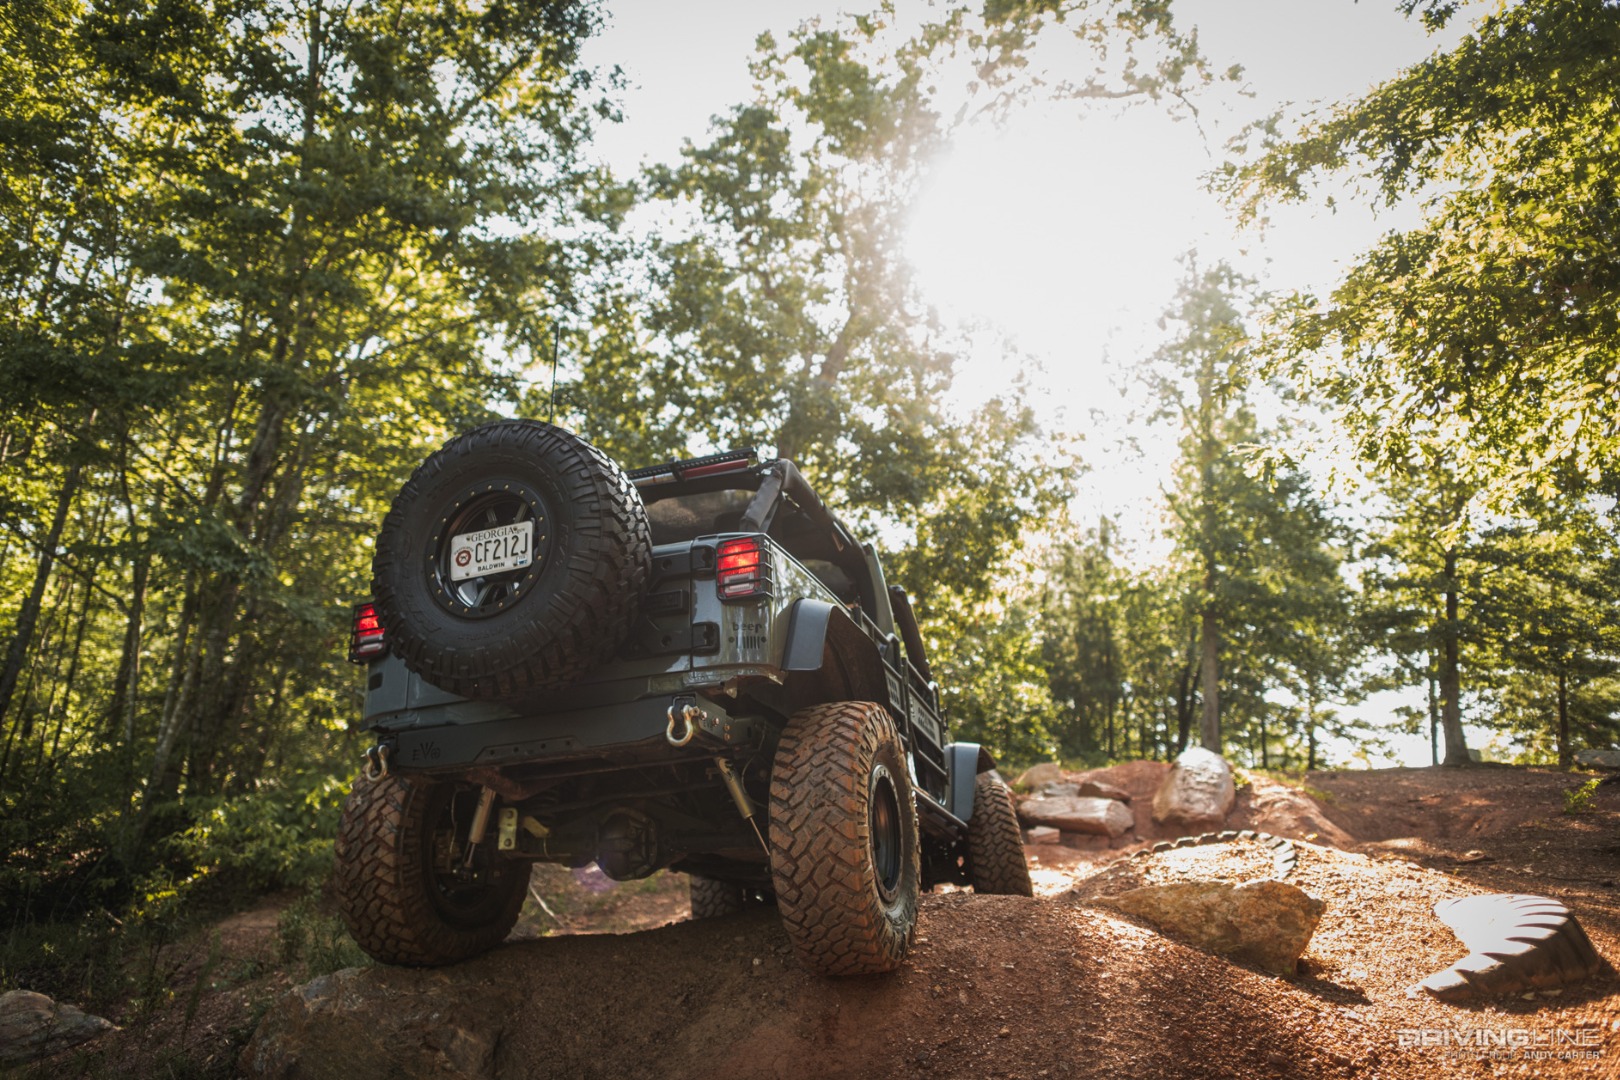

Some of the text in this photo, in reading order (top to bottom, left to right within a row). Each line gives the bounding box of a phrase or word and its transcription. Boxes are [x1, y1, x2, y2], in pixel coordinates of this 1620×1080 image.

[471, 527, 514, 542] GEORGIA
[475, 533, 528, 563] CF212J
[478, 562, 505, 572] BALDWIN
